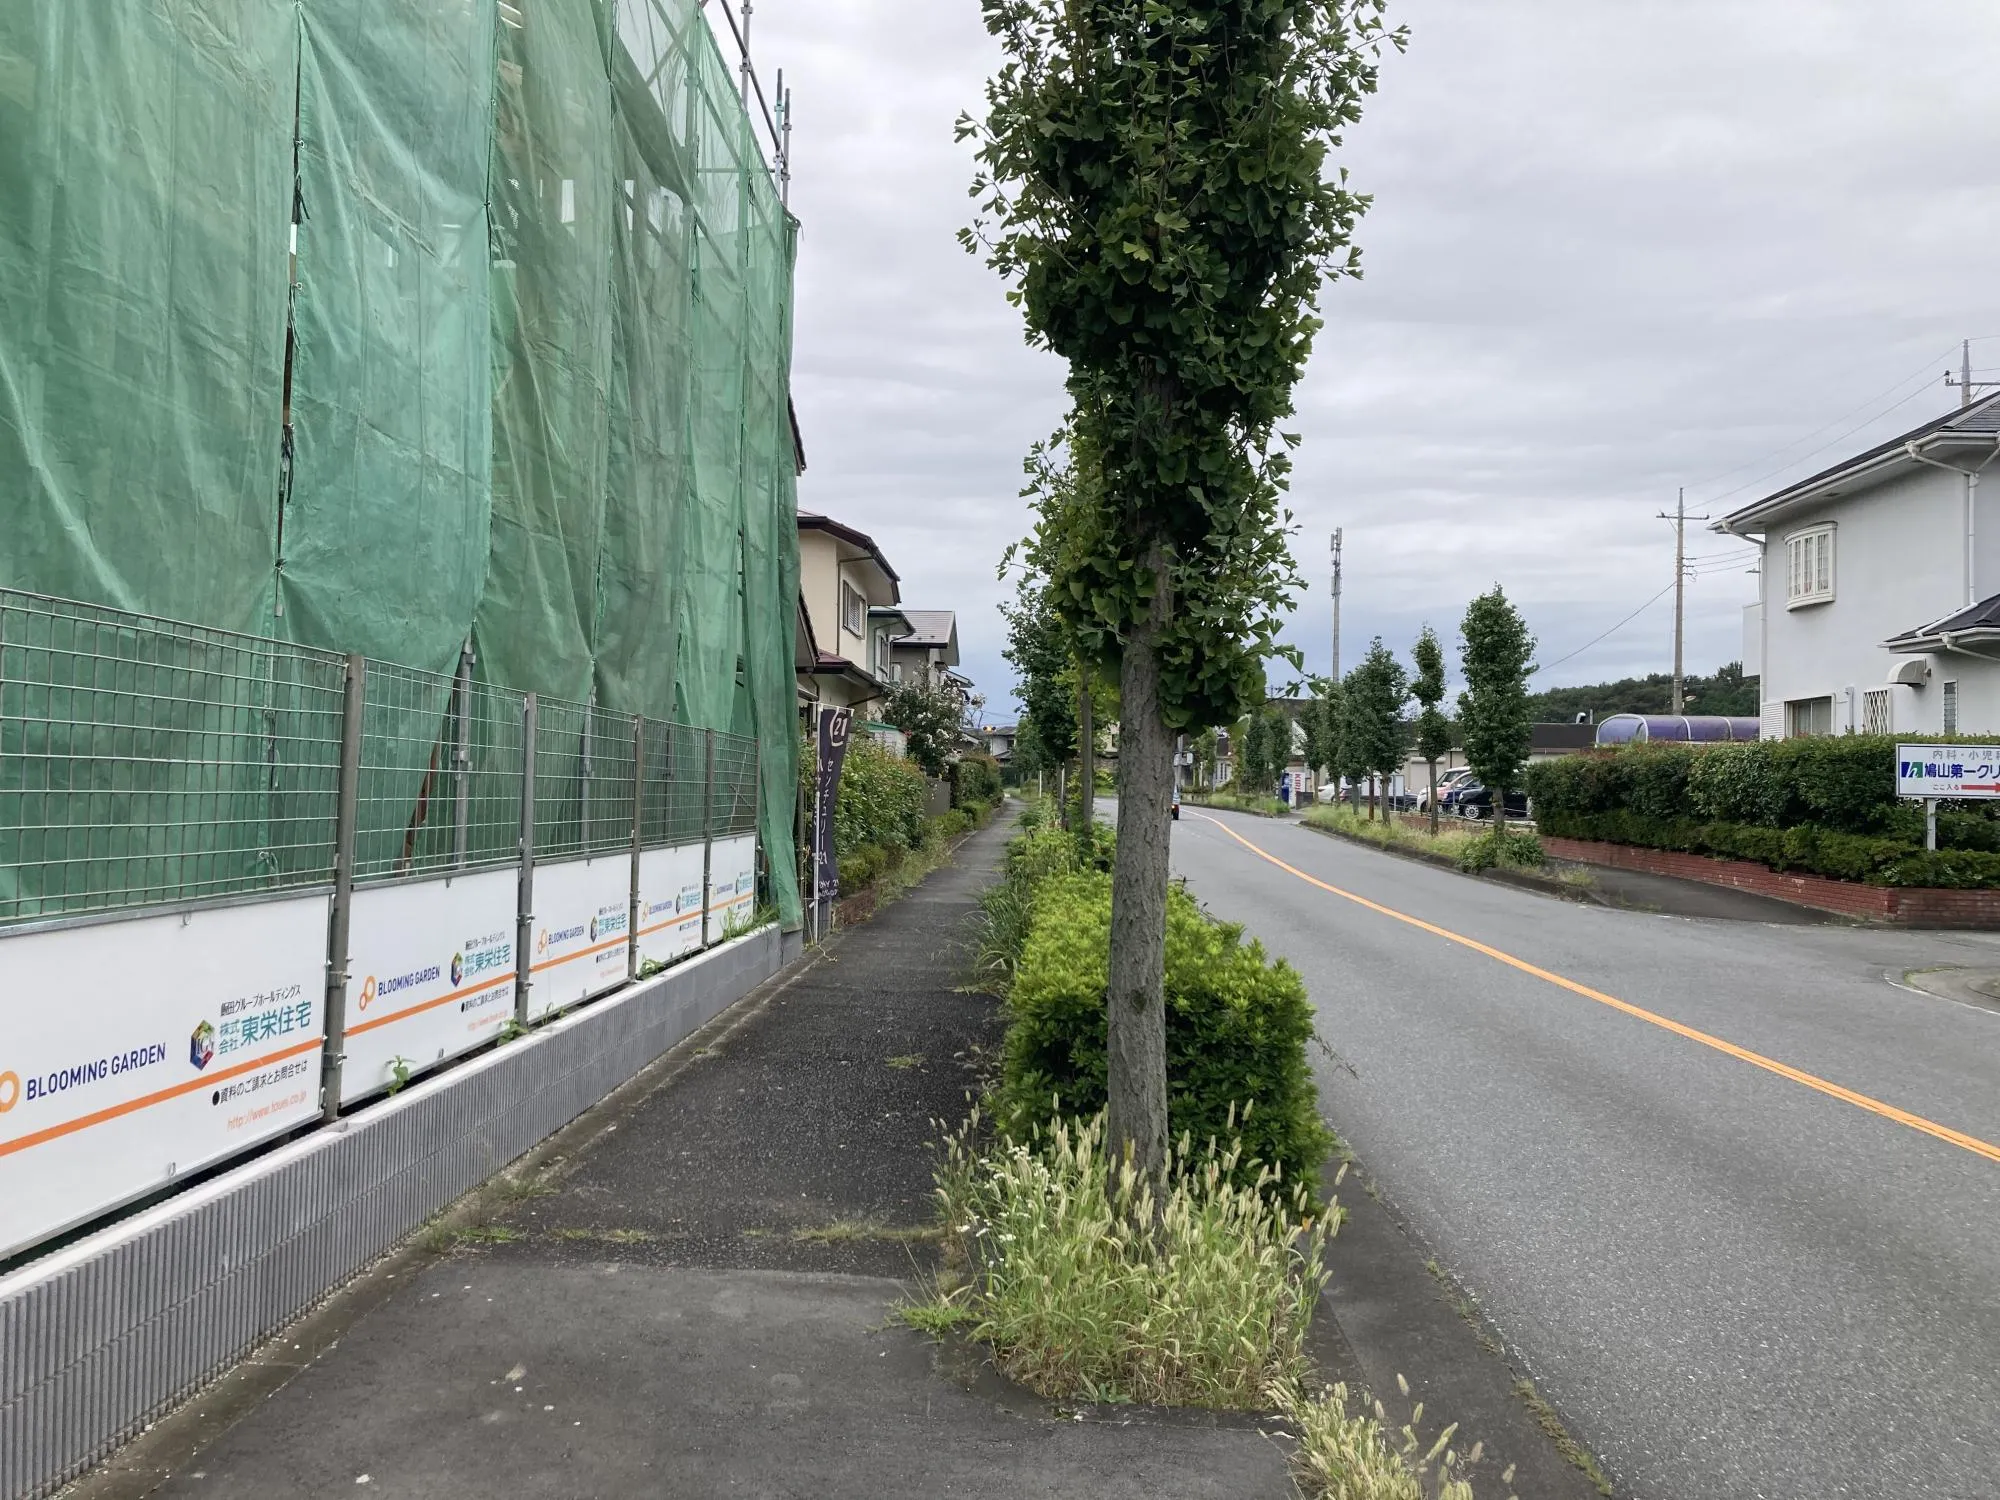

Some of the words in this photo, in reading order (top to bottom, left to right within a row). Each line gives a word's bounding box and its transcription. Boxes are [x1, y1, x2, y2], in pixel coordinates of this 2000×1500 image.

[1933, 783, 1959, 791] ここ入る
[548, 929, 569, 945] BLOOMING
[569, 925, 585, 939] GARDEN
[378, 975, 414, 996] BLOOMING
[415, 965, 441, 984] GARDEN
[241, 1000, 312, 1047] 東栄住宅
[26, 1059, 108, 1101] BLOOMING
[111, 1042, 166, 1075] GARDEN
